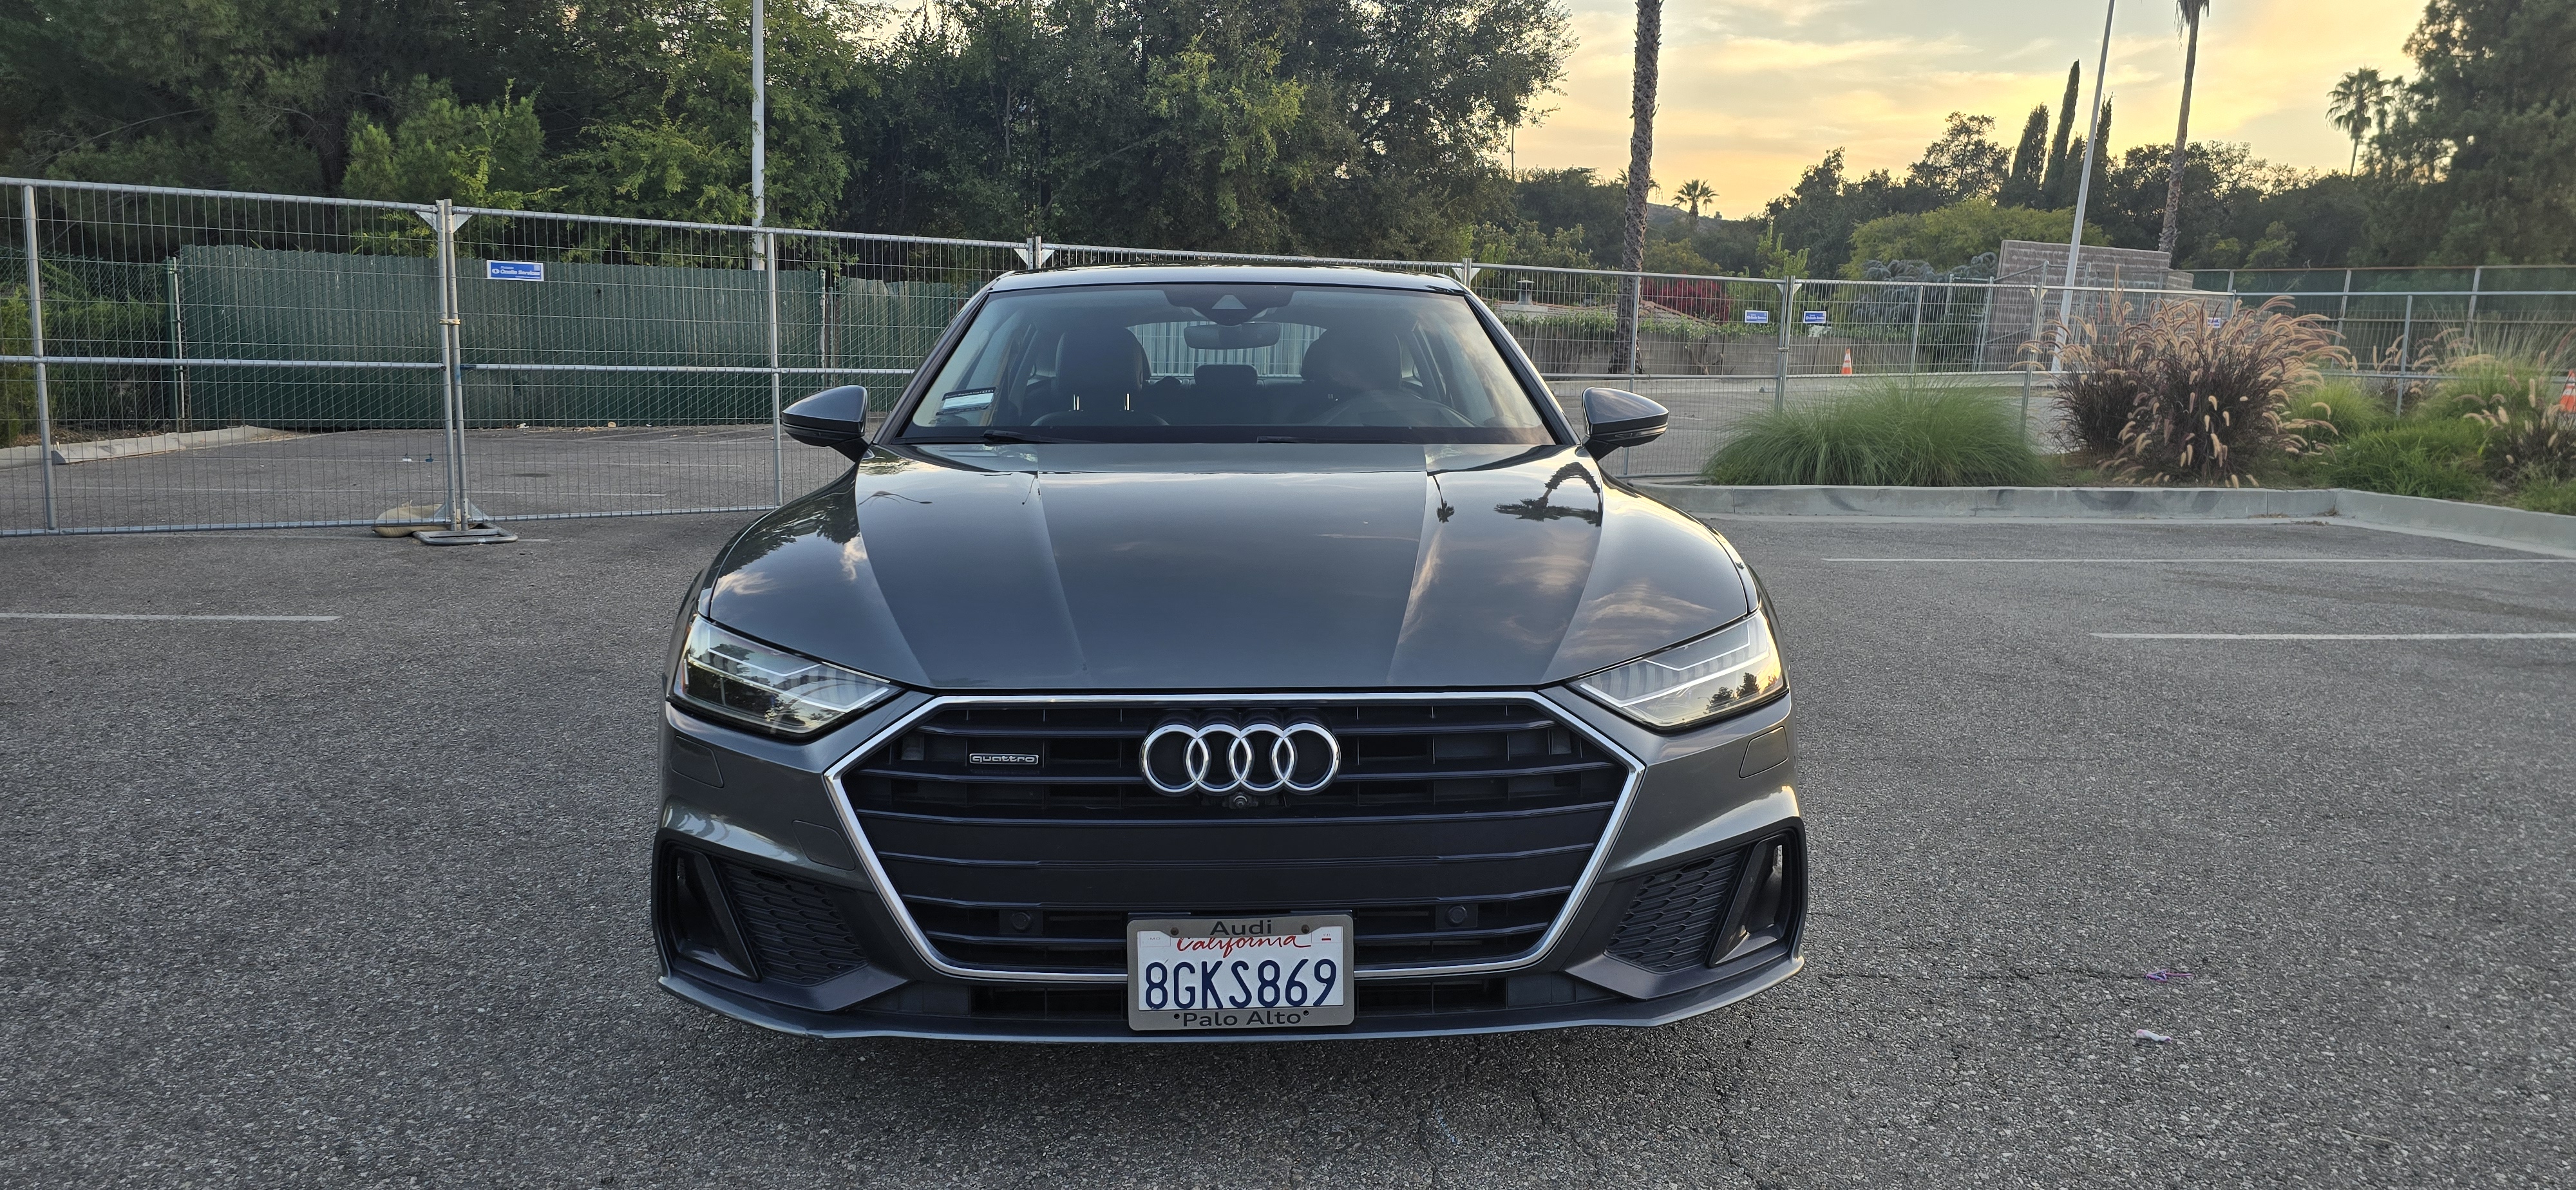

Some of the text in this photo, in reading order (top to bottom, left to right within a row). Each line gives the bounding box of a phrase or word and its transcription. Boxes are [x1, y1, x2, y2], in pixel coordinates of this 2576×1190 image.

[1209, 920, 1273, 936] Audi
[1177, 935, 1312, 958] California
[1145, 958, 1337, 1010] 8GKS869
[1182, 1010, 1302, 1027] Palo Alto
